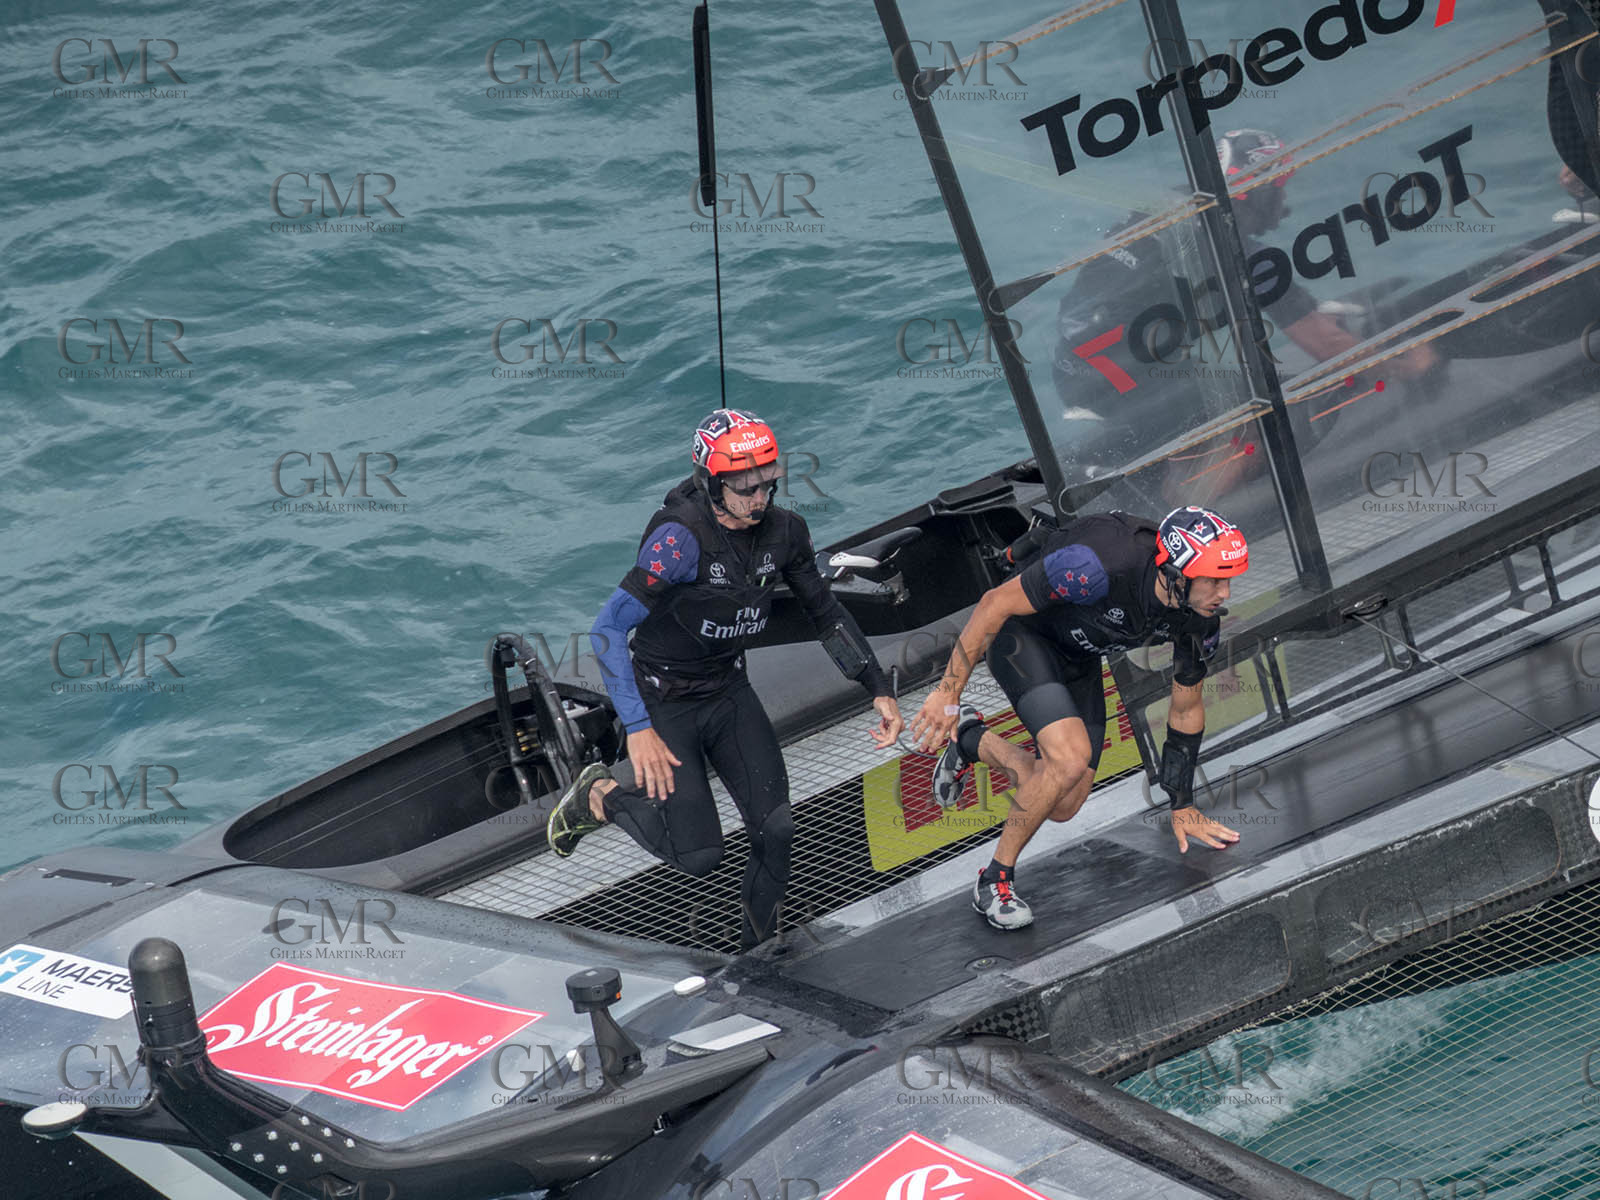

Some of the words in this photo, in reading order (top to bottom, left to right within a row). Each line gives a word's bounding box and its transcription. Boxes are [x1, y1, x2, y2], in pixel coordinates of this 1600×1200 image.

[1020, 0, 1457, 176] Torpedo
[729, 434, 770, 453] Emirates
[1162, 536, 1177, 560] TOYOTA
[736, 607, 760, 621] Fly
[17, 976, 74, 999] LINE
[41, 960, 133, 993] MAERS
[204, 982, 478, 1089] Steinlager
